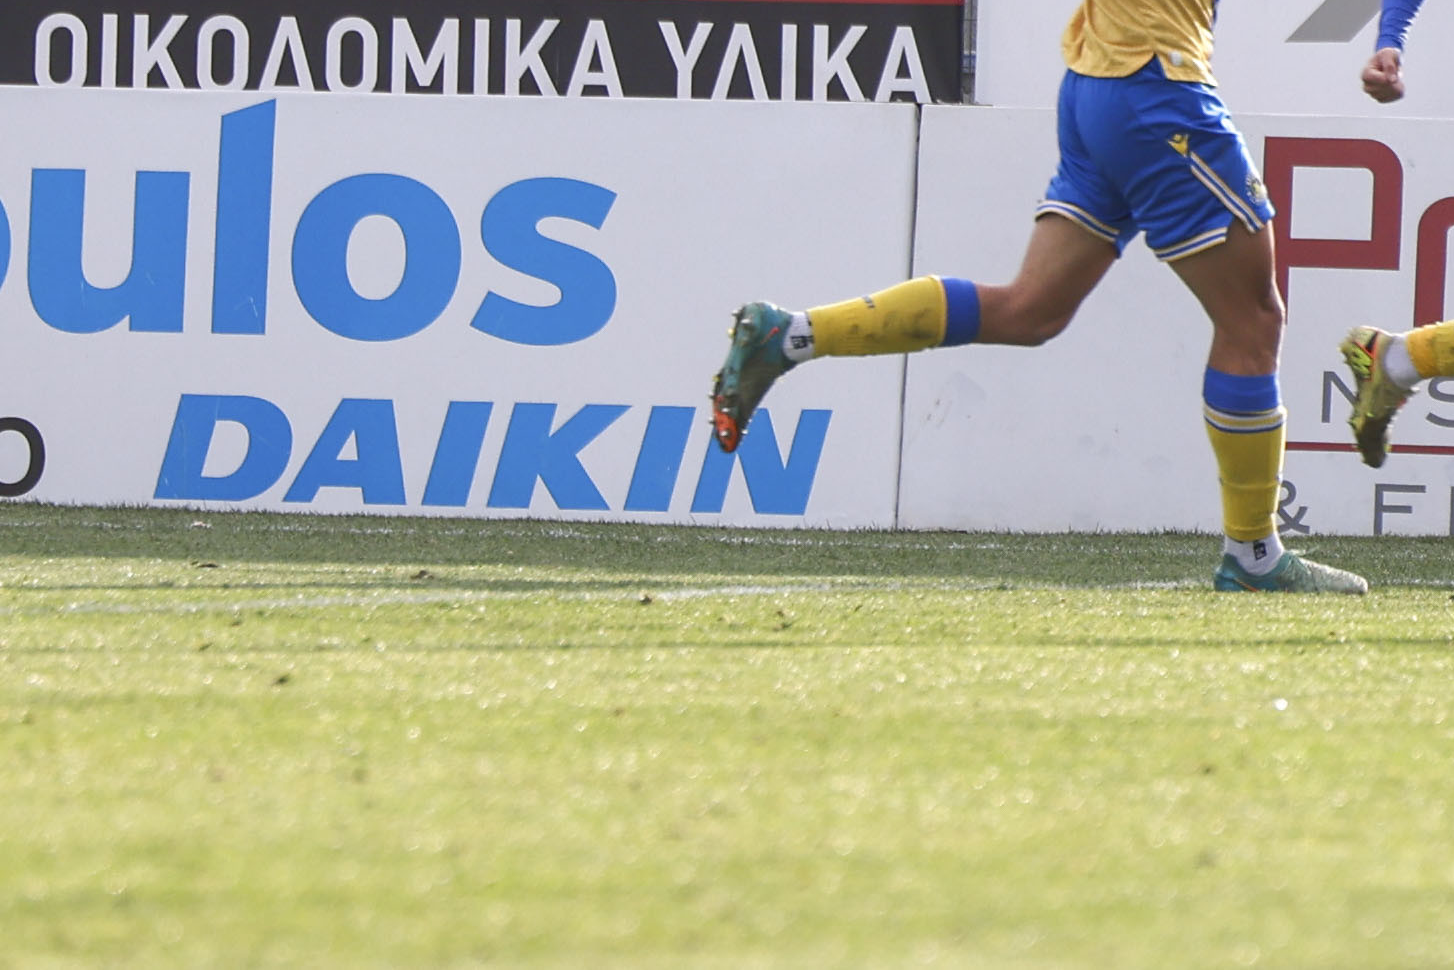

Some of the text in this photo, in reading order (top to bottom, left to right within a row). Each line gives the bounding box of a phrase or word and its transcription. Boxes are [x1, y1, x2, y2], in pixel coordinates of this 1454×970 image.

[658, 19, 932, 103] ΥΛΙΚΑ
[0, 99, 617, 347] ulos
[154, 392, 832, 516] DAIKIN
